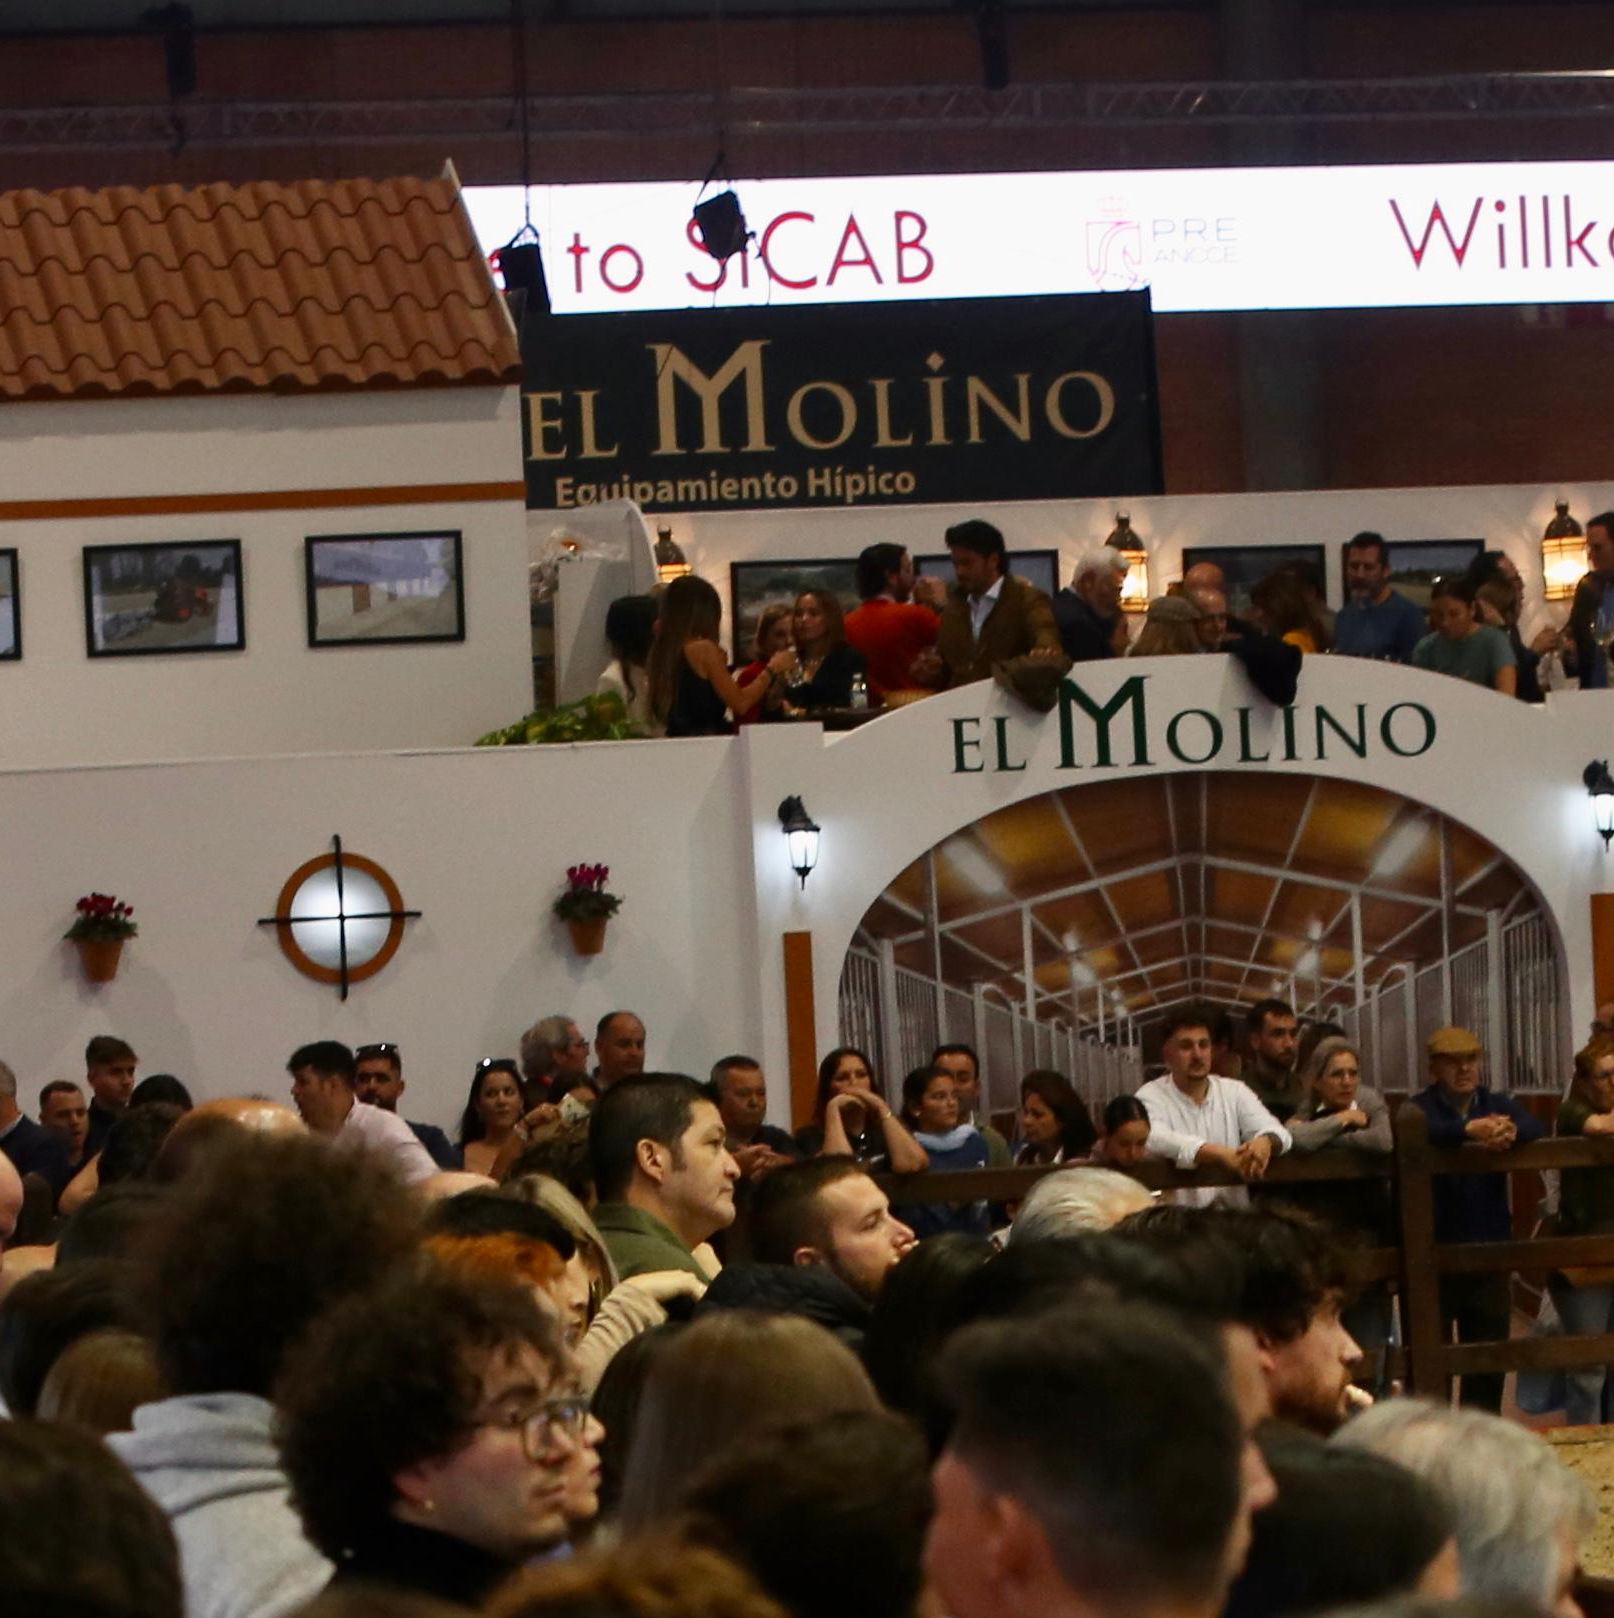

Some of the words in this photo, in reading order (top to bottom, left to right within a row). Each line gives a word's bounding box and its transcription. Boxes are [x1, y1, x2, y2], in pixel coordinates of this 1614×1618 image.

[1152, 216, 1238, 242] PRE
[567, 232, 645, 294] to
[523, 390, 620, 462] EL
[555, 471, 799, 508] Equipamiento
[807, 465, 916, 504] Hípico
[949, 715, 1028, 774] EL
[1054, 674, 1438, 770] MOLINO
